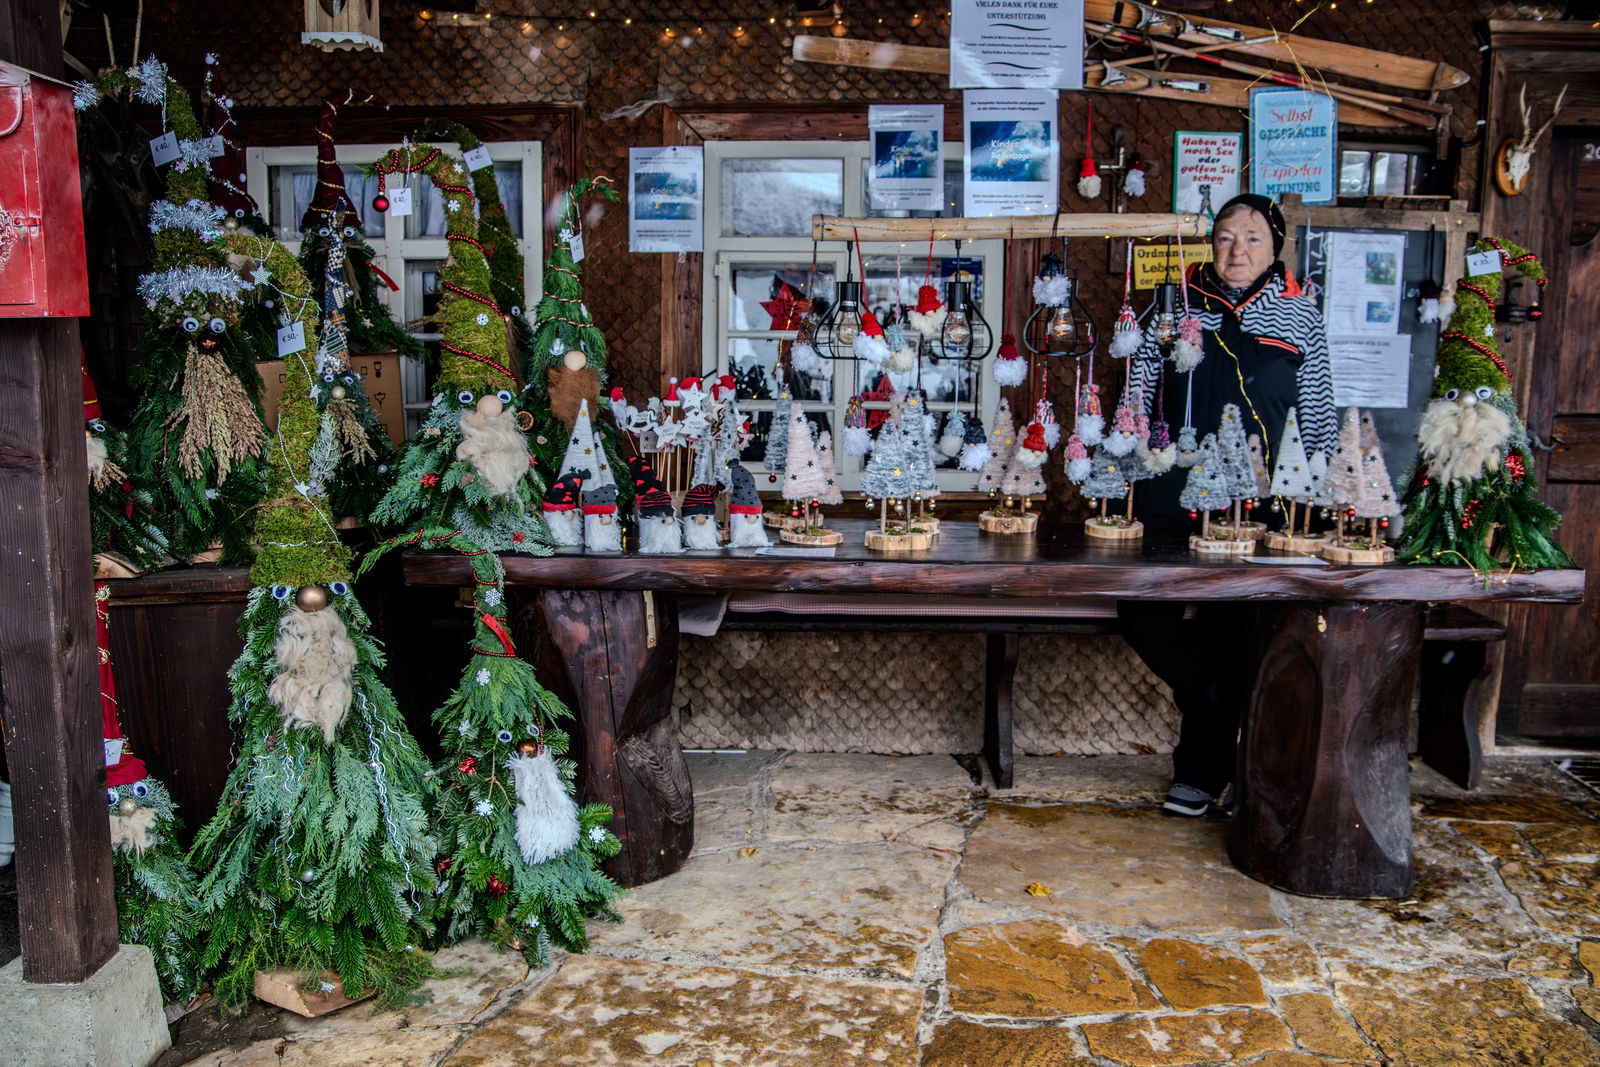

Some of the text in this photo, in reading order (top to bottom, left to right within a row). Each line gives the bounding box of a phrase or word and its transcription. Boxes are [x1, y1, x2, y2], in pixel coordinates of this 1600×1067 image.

[976, 0, 1000, 8] VIELEN
[1024, 0, 1038, 8] FÜR
[987, 11, 1046, 20] UNTERSTÜTZUNG
[1268, 108, 1313, 124] Selbst
[1181, 137, 1237, 147] Haben Sie
[1184, 147, 1233, 155] noch Sex
[1181, 165, 1236, 174] golfen Sie
[1261, 163, 1323, 181] Experten
[1192, 174, 1224, 182] schon
[1266, 181, 1321, 195] MEINUNG
